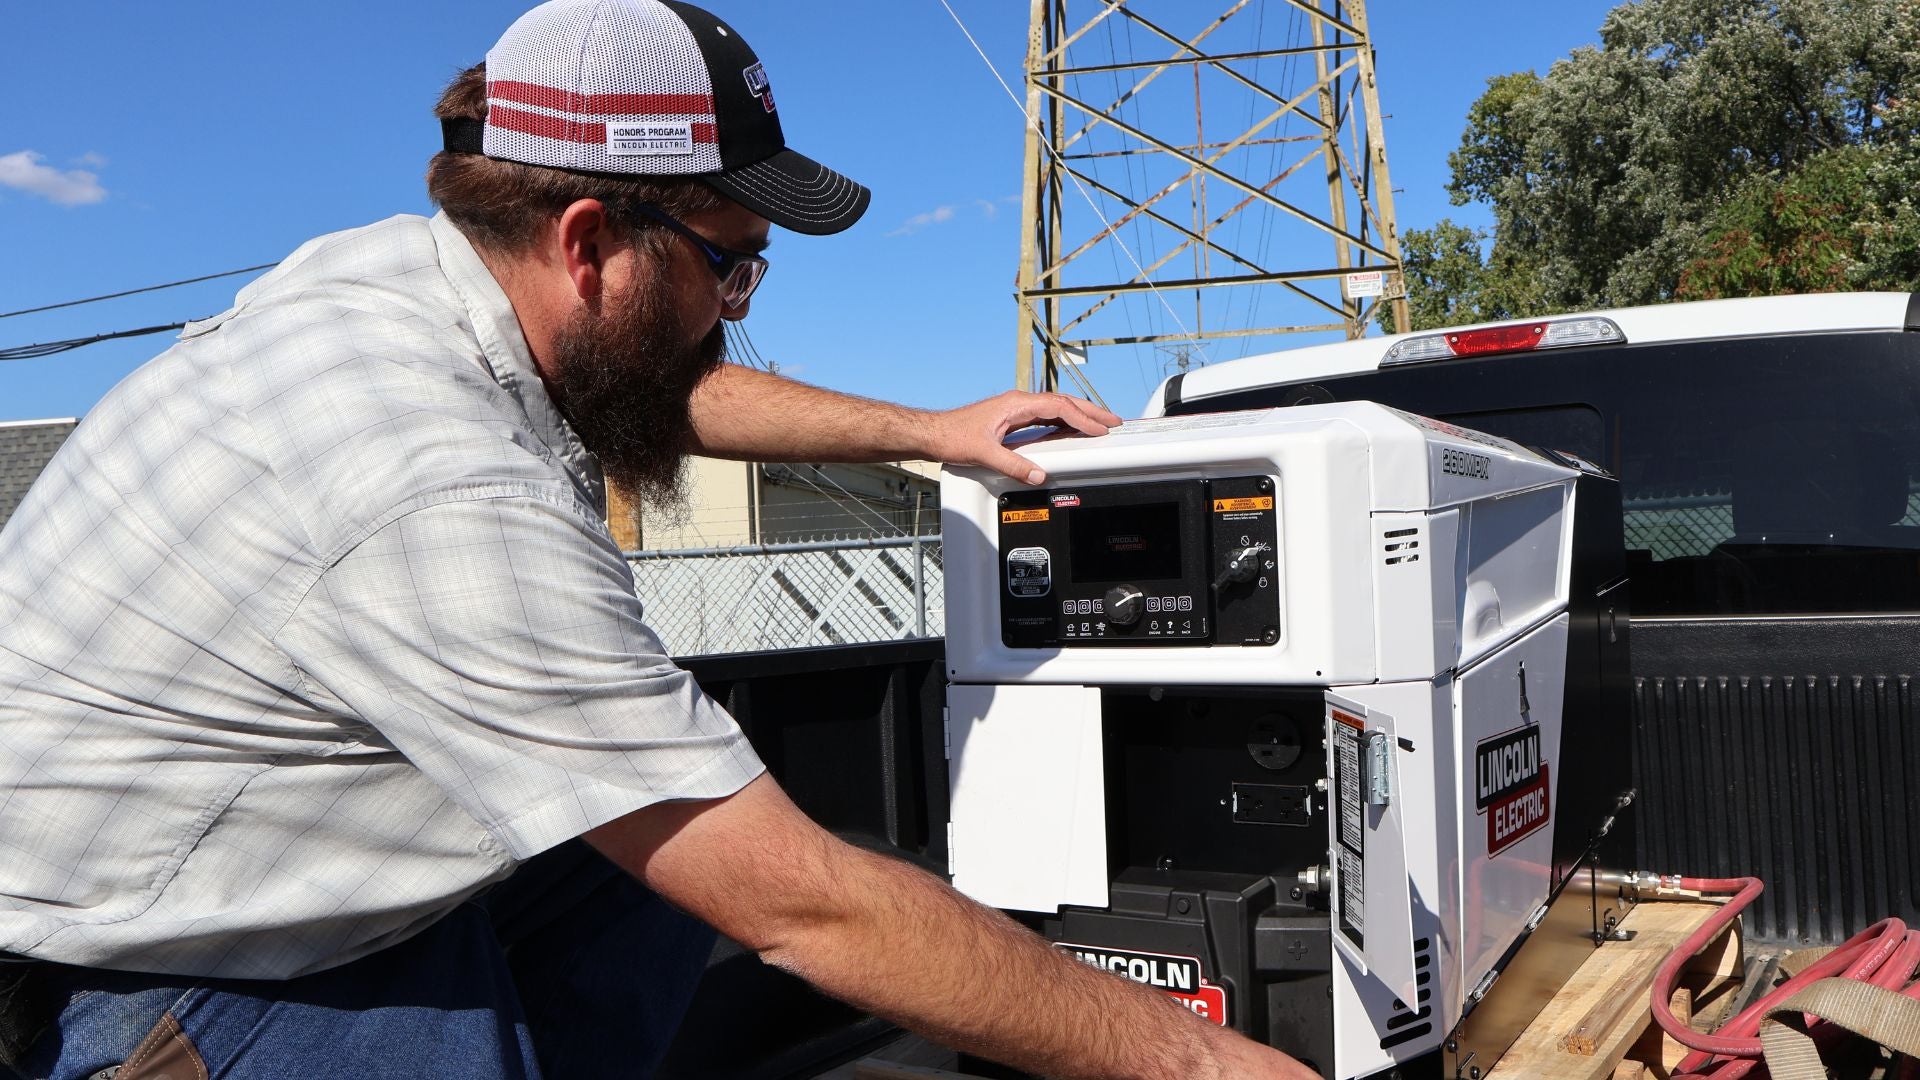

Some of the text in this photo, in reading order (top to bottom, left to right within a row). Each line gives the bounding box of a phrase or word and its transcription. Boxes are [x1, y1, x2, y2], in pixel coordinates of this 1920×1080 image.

[613, 127, 687, 136] HONORS PROGRAM
[1443, 448, 1490, 479] 260MPX
[1108, 536, 1139, 544] LINCOLN
[1480, 734, 1538, 800] LINCOLN
[1495, 786, 1545, 842] ELECTRIC
